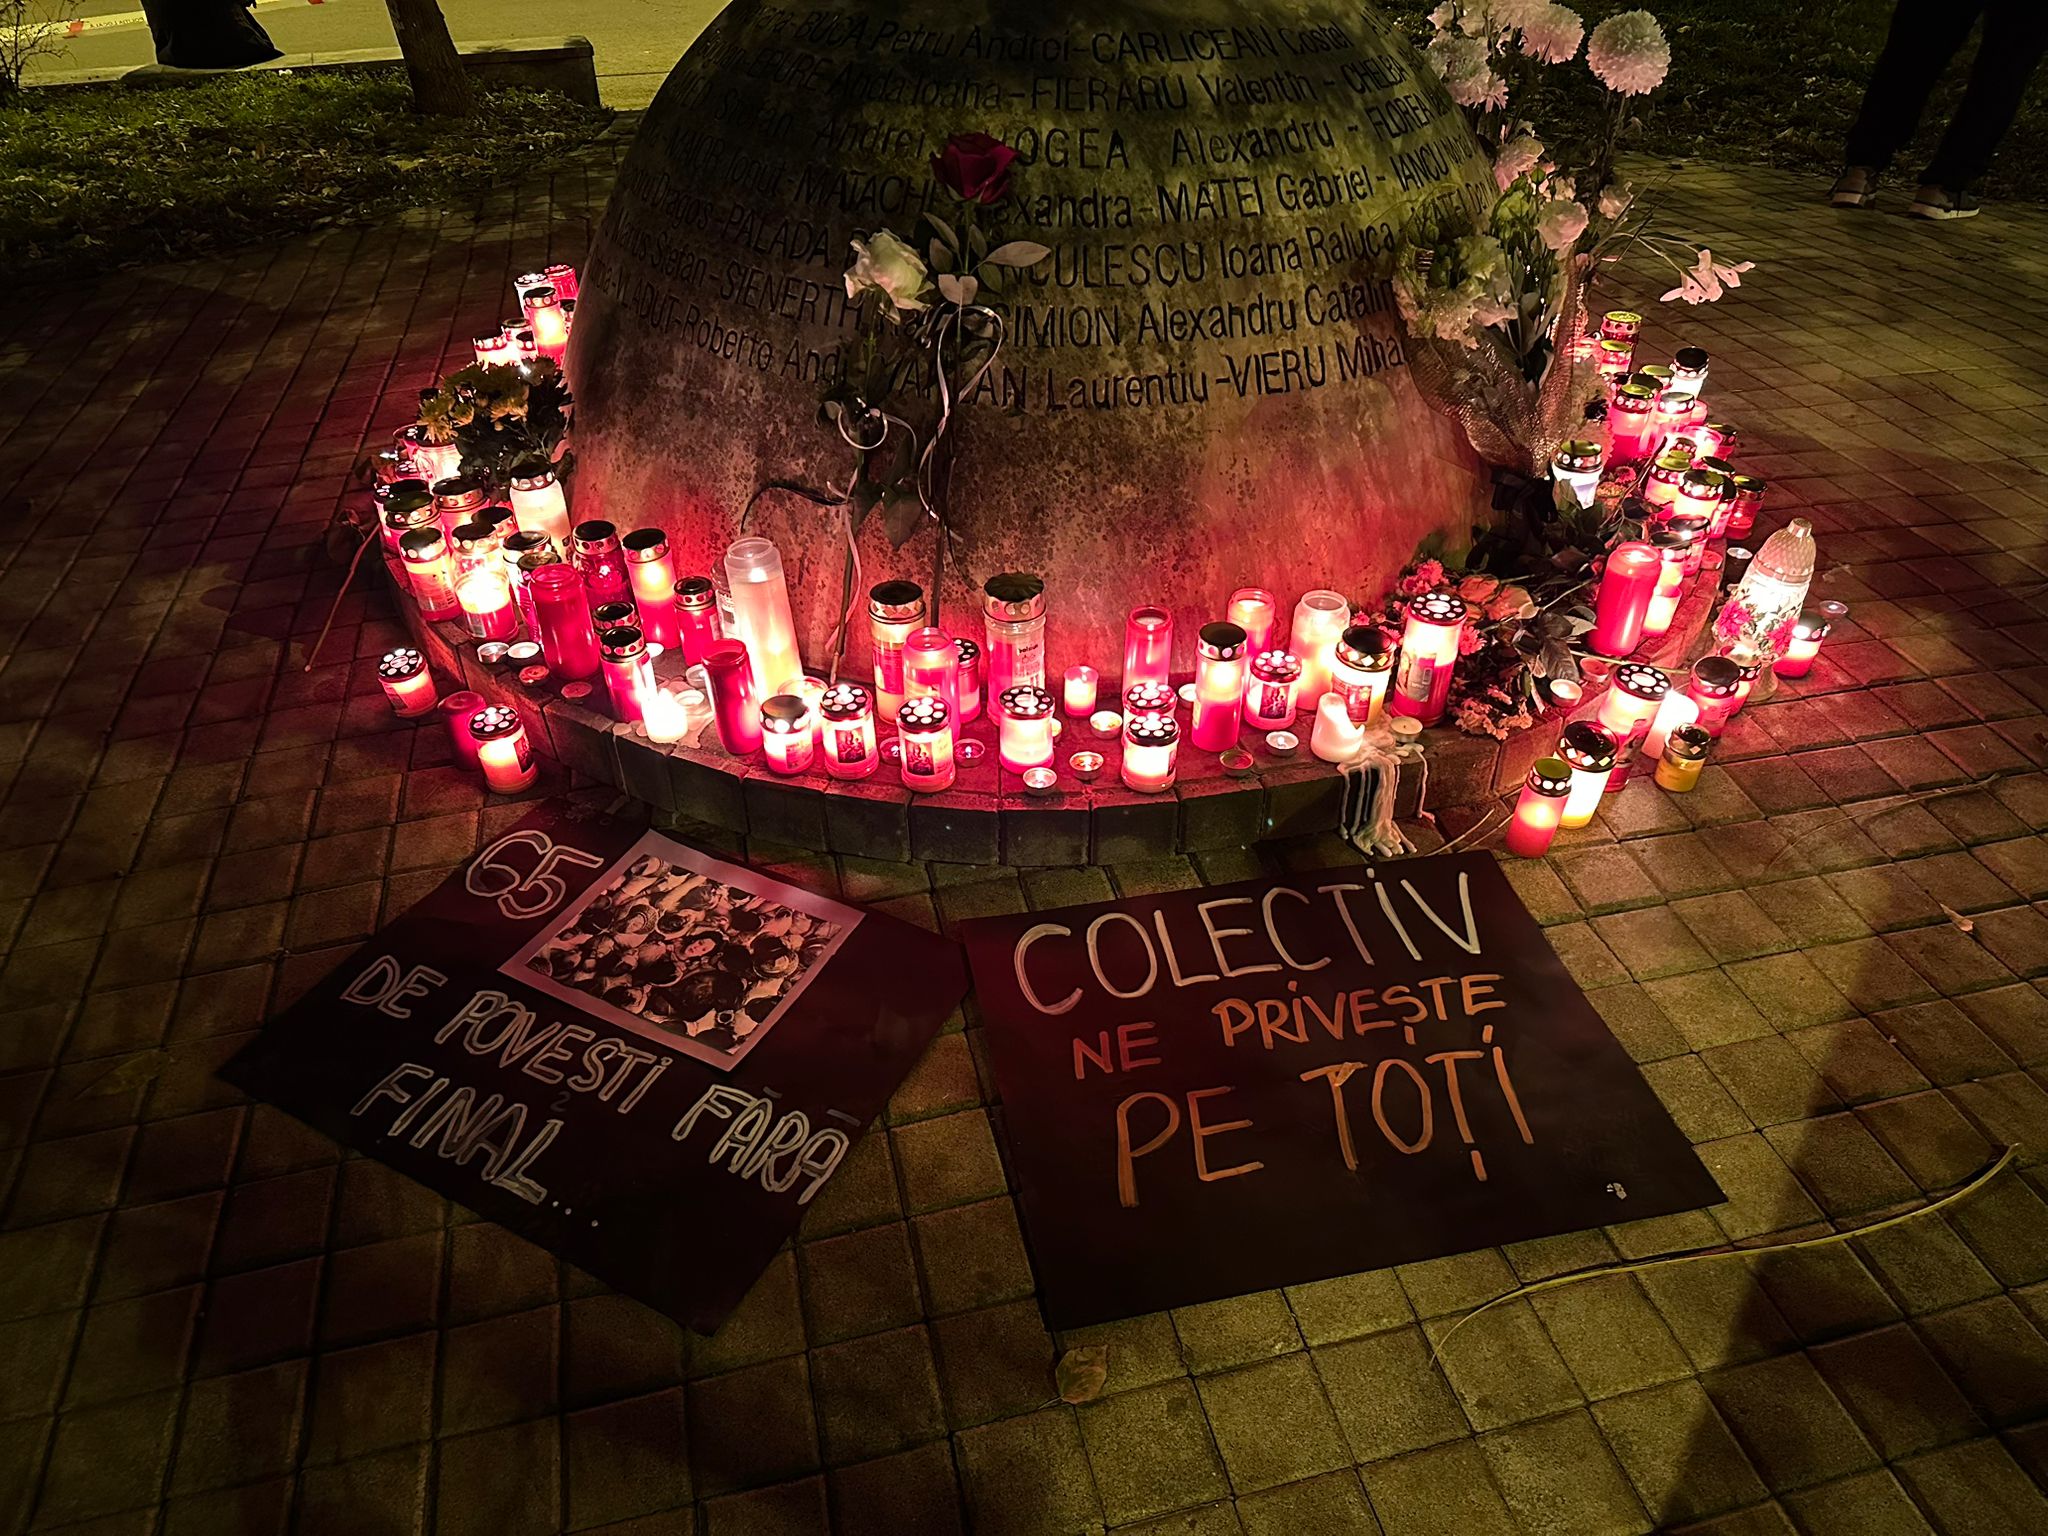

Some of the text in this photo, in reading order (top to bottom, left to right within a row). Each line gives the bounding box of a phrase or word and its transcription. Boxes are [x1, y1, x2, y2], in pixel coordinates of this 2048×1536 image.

[871, 20, 955, 57] Petru
[1197, 70, 1318, 106] Valentin
[811, 115, 926, 160] Andrei
[1003, 126, 1130, 169] OGEA
[1172, 119, 1335, 167] Alexandru
[1364, 92, 1436, 142] FLOREA
[1275, 164, 1375, 207] Gabriel
[1389, 140, 1450, 193] IANCU
[1220, 238, 1302, 279] Ioana
[1306, 222, 1396, 267] Raluca
[1138, 292, 1298, 344] Alexandru
[1047, 361, 1209, 411] Laurentiu
[465, 829, 604, 919] 65
[340, 955, 448, 1019] DE
[1072, 1021, 1163, 1080] NE
[1117, 1085, 1265, 1208] PE
